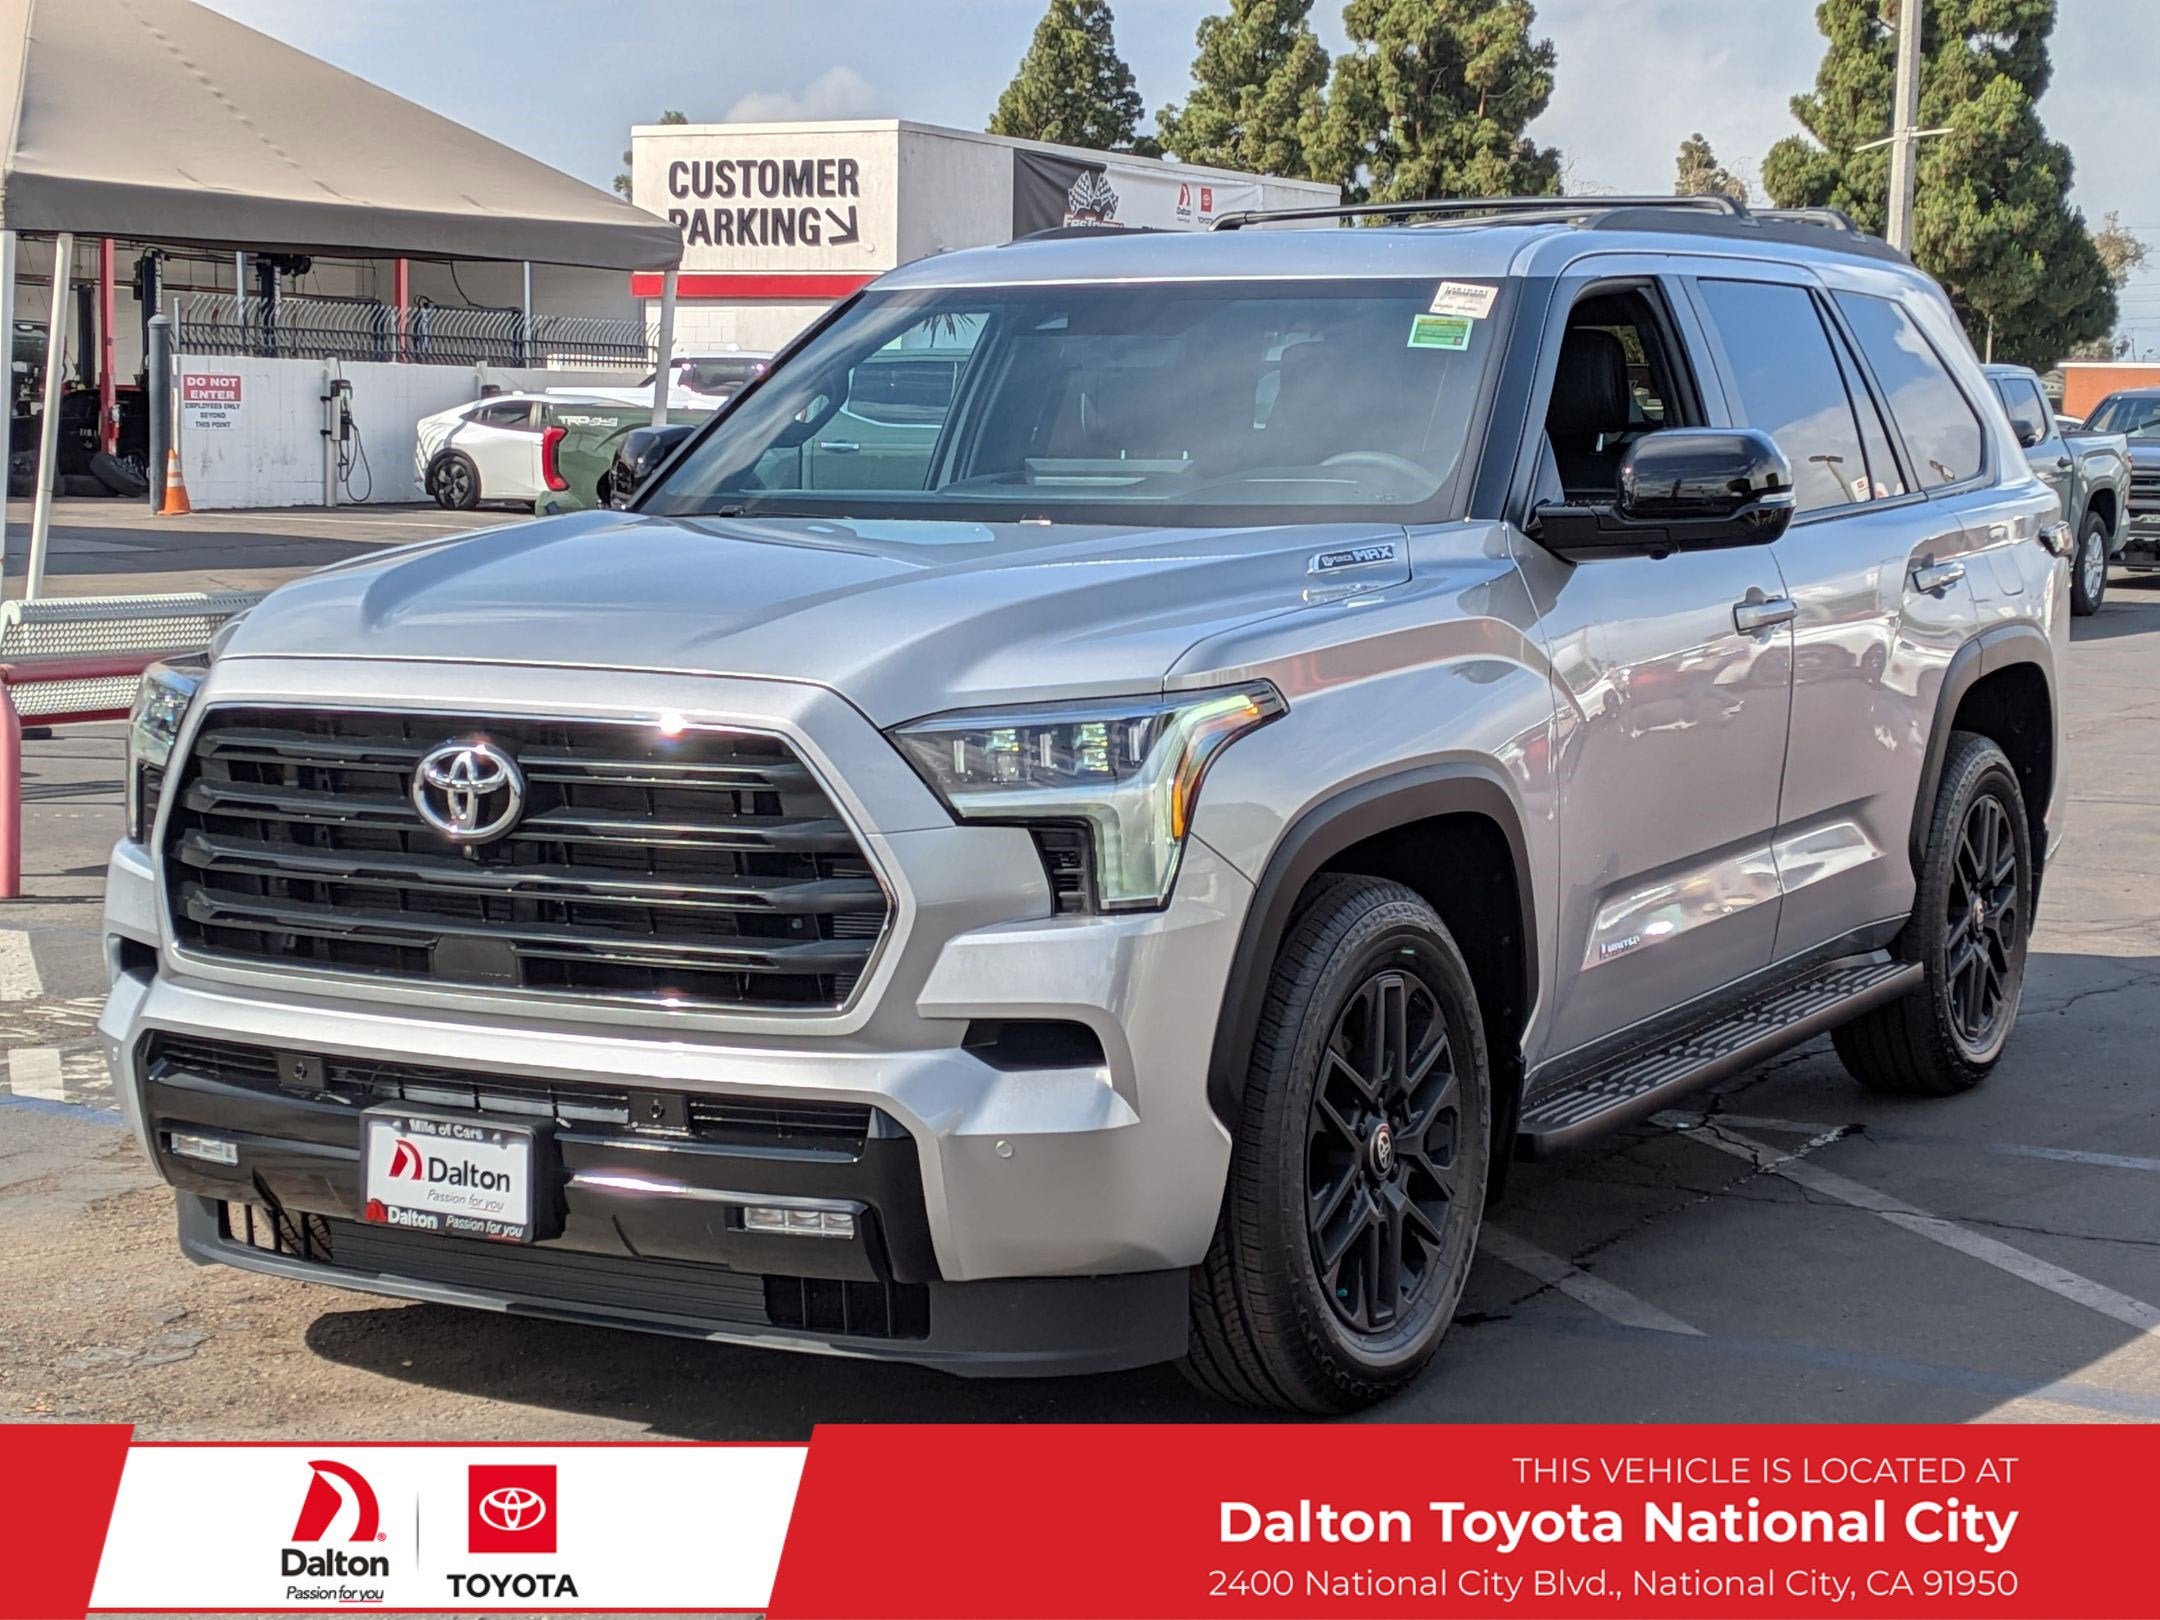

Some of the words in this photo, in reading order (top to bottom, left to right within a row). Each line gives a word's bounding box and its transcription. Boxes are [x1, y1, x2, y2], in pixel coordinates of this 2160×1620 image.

[668, 158, 860, 199] CUSTOMER
[186, 377, 206, 387] DO
[210, 377, 238, 387] NOT
[190, 389, 235, 400] ENTER
[200, 411, 226, 419] BEYOND
[1352, 546, 1393, 562] MAX
[409, 1119, 436, 1135] Mile
[438, 1121, 452, 1136] of
[453, 1124, 484, 1140] Cars
[428, 1157, 511, 1192] Dalton
[427, 1189, 466, 1205] Passion
[468, 1194, 484, 1207] for
[484, 1198, 504, 1212] you
[387, 1206, 439, 1230] Dalton
[445, 1215, 485, 1232] Passion
[486, 1220, 503, 1236] for
[502, 1225, 523, 1238] you
